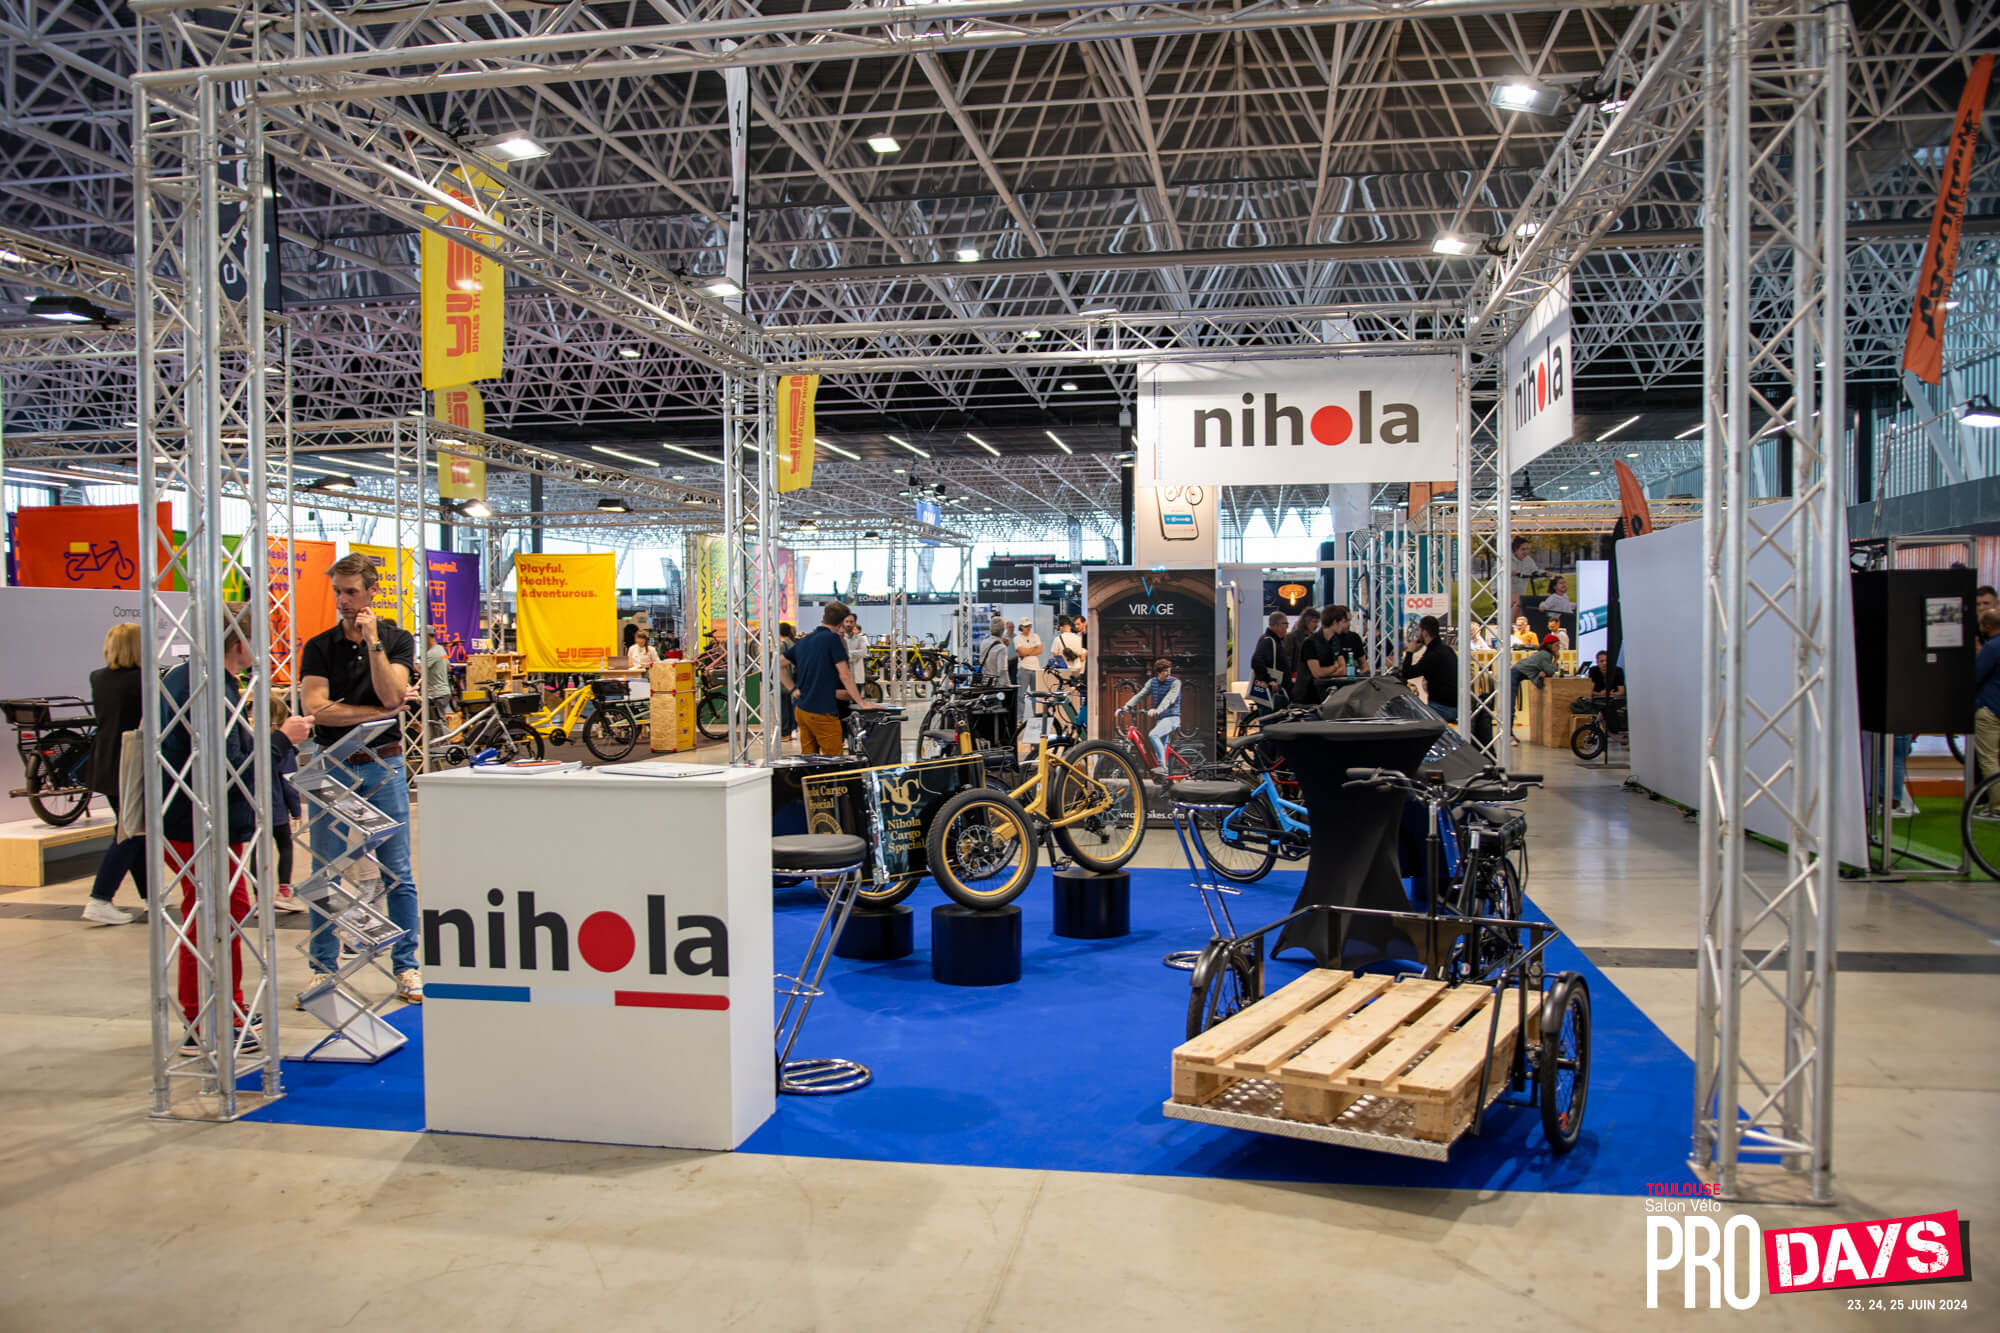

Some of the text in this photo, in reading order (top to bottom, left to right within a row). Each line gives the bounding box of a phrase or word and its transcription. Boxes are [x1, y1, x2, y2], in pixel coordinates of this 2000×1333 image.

[472, 314, 480, 353] BIKES
[1515, 335, 1563, 432] nihola
[1194, 390, 1420, 448] nihola
[520, 563, 565, 574] Playful.
[520, 576, 568, 587] Healthy.
[992, 578, 1032, 587] trackap
[521, 588, 598, 598] Adventurous.
[1128, 603, 1174, 615] VIRAGE
[820, 785, 848, 797] Cargo
[887, 817, 922, 831] Nihola
[889, 829, 921, 842] Cargo
[888, 837, 926, 854] Special
[422, 888, 730, 977] nihola
